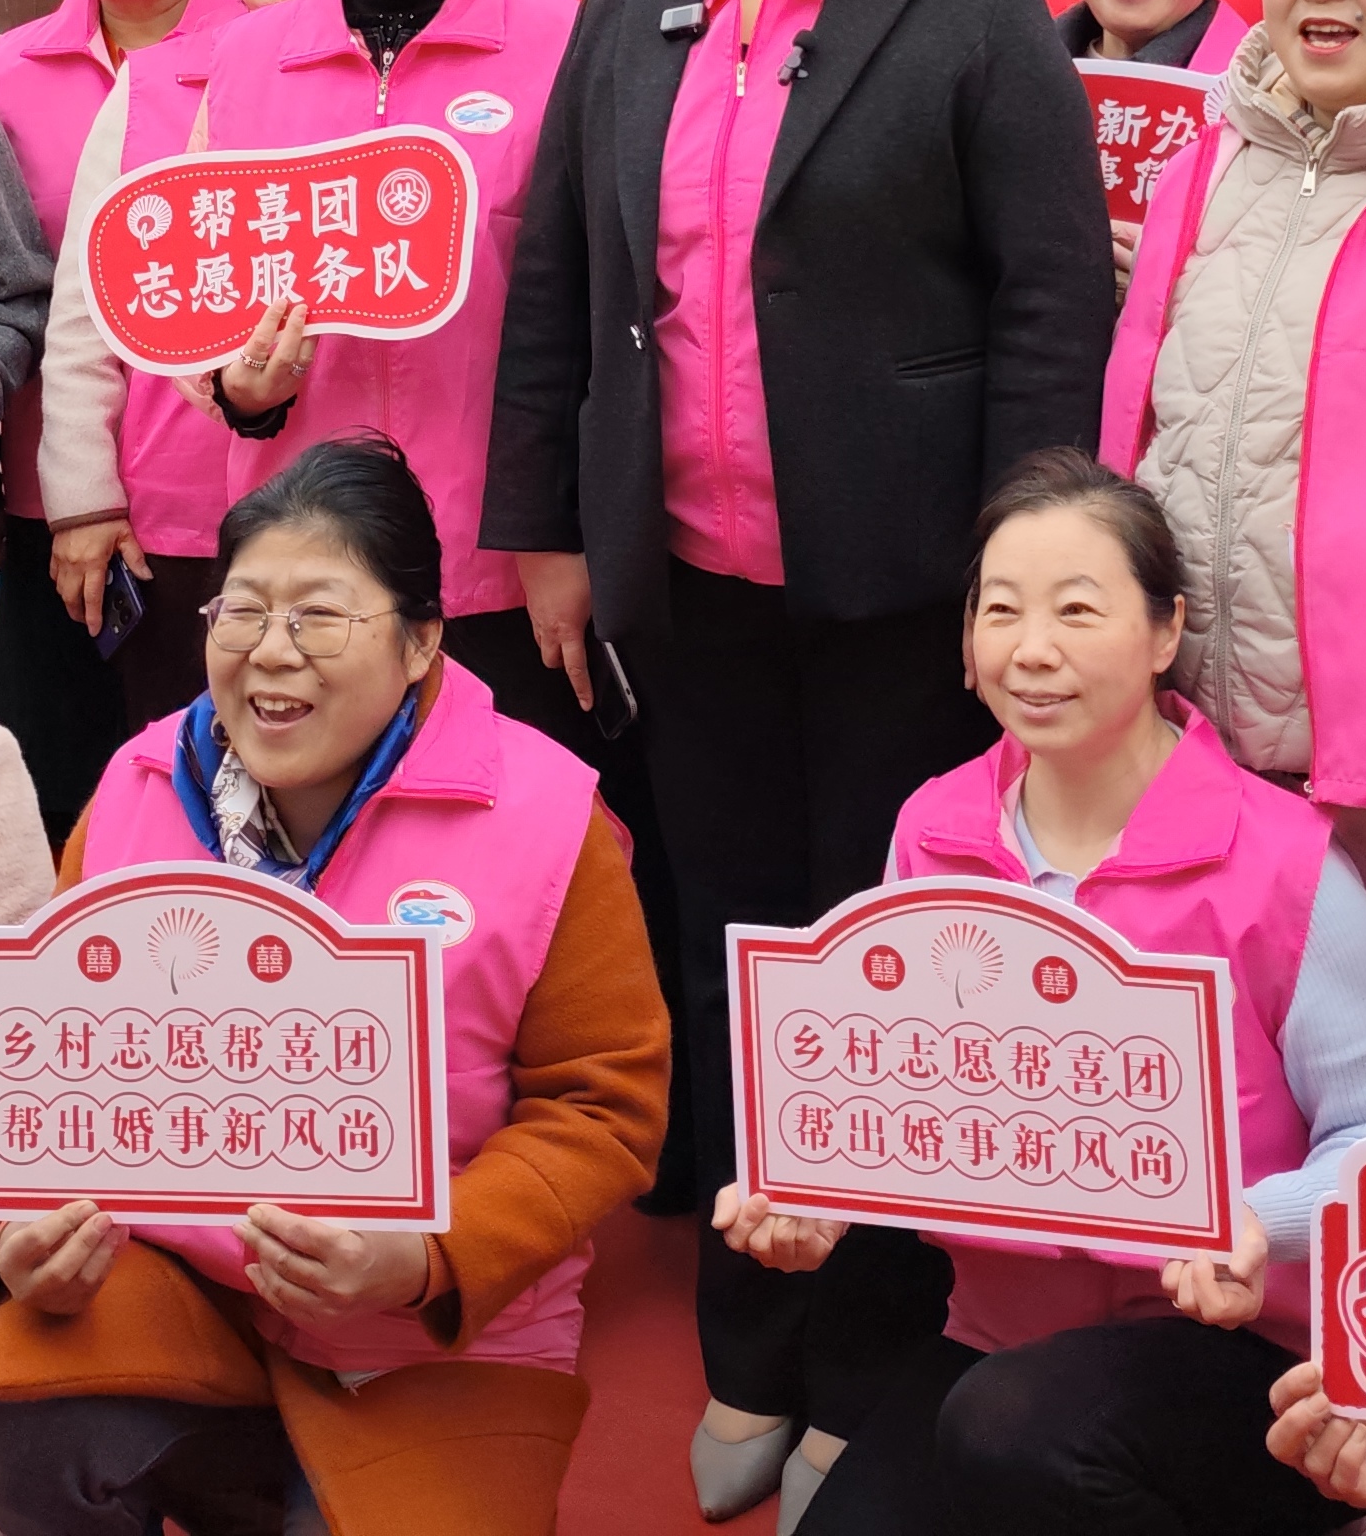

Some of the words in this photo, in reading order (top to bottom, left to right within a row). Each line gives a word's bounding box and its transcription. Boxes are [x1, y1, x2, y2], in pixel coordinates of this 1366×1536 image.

[1096, 98, 1199, 154] 新办
[189, 175, 359, 249] 帮喜团
[126, 240, 430, 319] 志愿服务队
[1, 1020, 378, 1074] 乡村志愿帮喜团
[792, 1023, 1168, 1102] 乡村志愿帮喜团
[0, 1102, 381, 1158] 帮出婚事新风尚
[793, 1101, 1174, 1186] 帮出婚事新风尚
